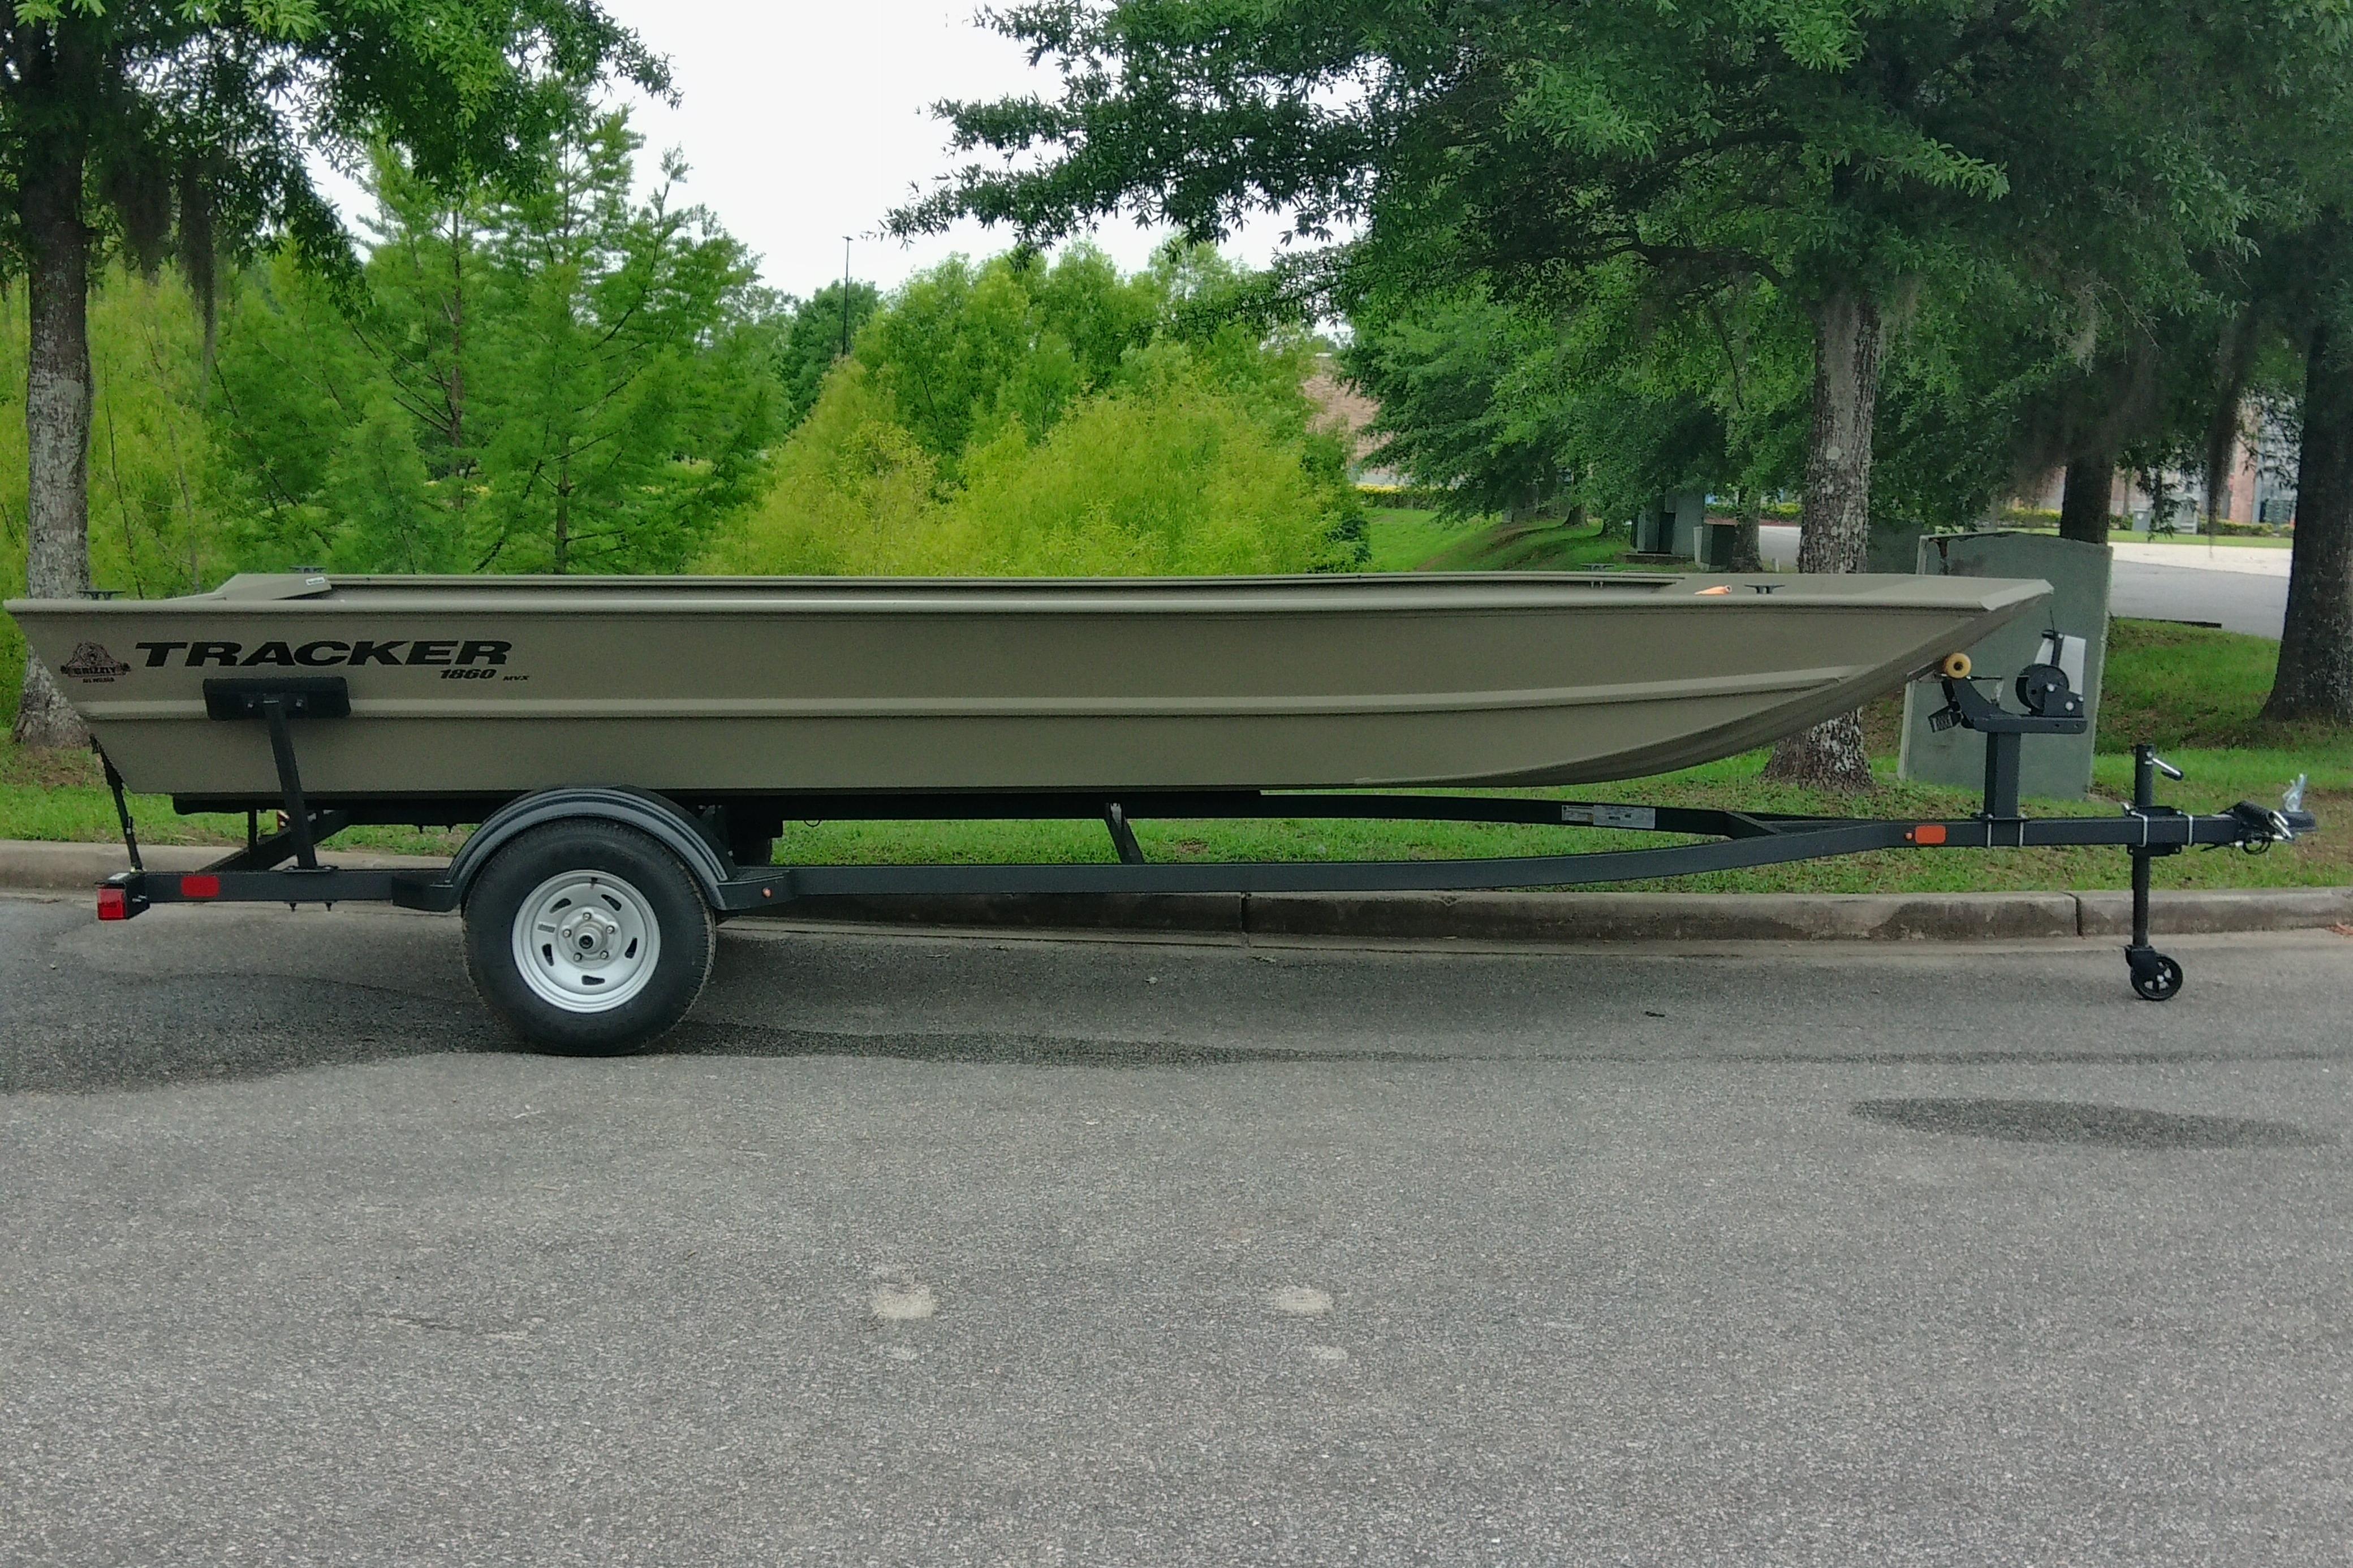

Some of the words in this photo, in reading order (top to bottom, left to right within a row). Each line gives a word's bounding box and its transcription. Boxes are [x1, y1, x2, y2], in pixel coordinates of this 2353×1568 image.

[135, 640, 512, 667] TRACKER
[74, 666, 116, 675] GRIZZLY
[440, 668, 497, 679] 1860
